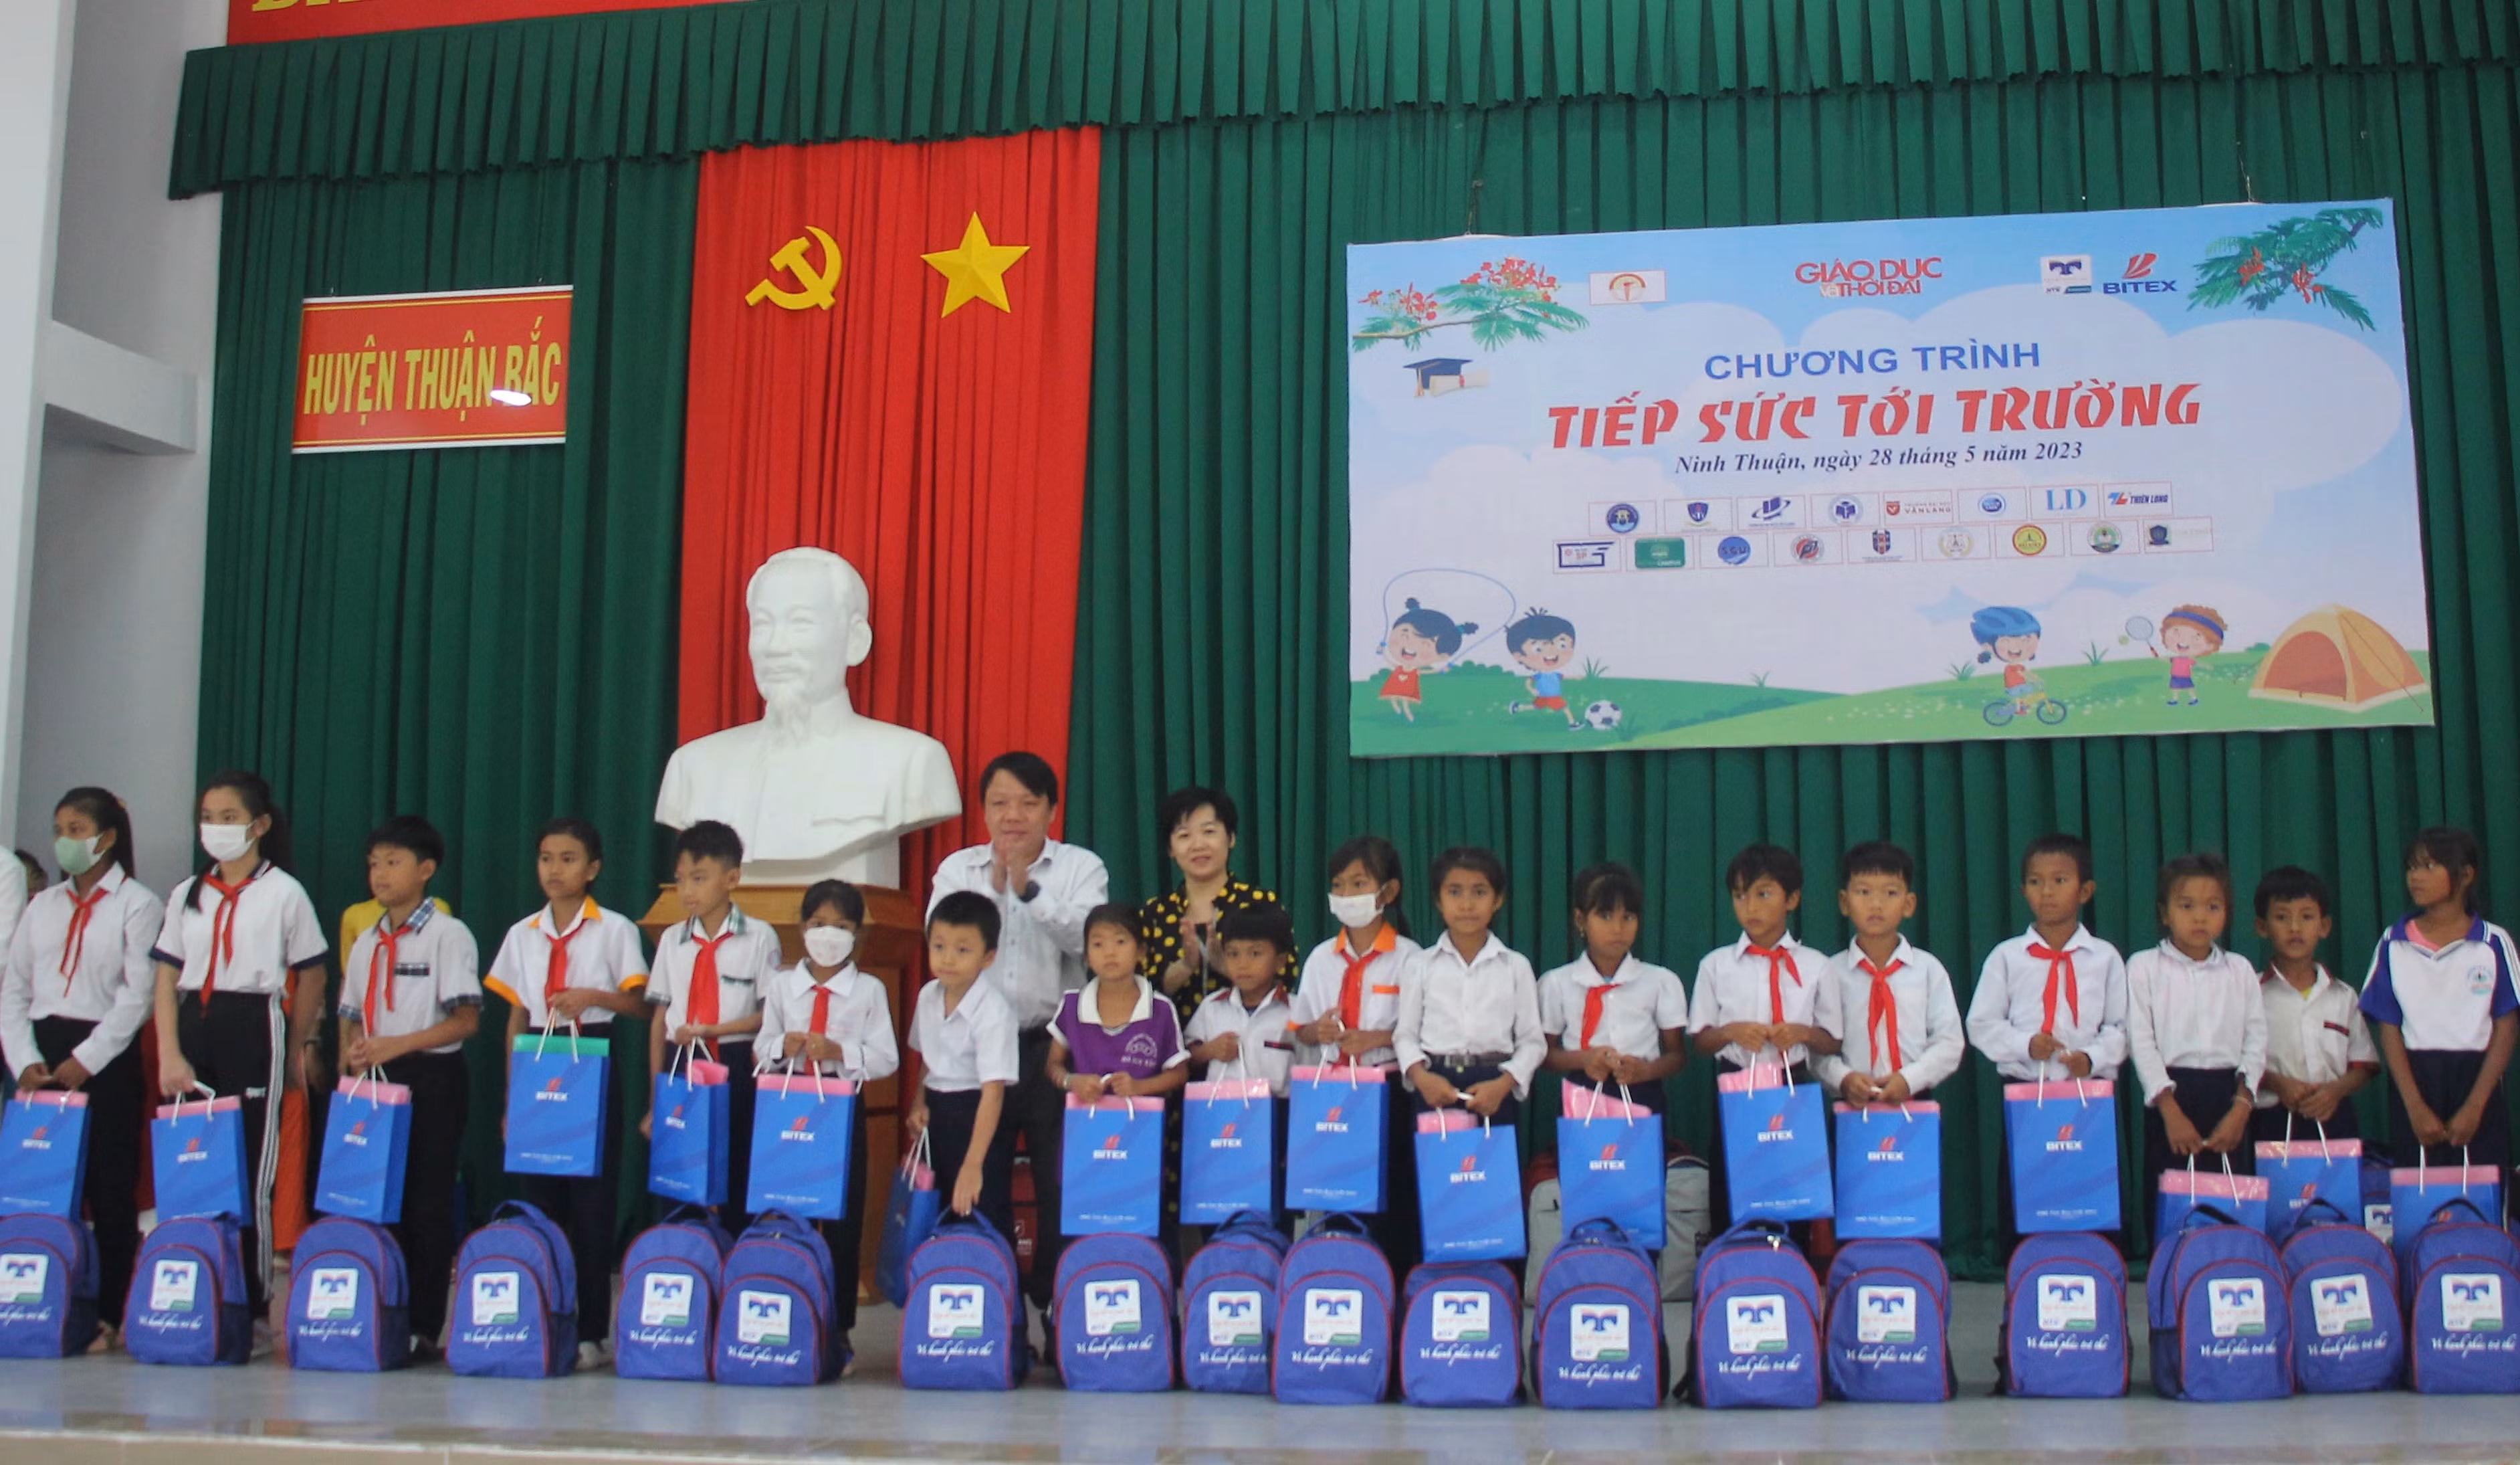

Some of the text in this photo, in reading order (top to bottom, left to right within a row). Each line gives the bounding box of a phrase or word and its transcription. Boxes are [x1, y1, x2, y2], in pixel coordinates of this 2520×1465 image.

[2103, 280, 2177, 294] BITEX
[1705, 338, 2040, 380] CHƯƠNG TRÌNH
[304, 316, 562, 426] HUYỆN THUẬN BẮC
[1548, 378, 2202, 448] TIẾP SỨC TỚI TRƯỜNG
[1675, 442, 2083, 474] Ninh Thuận, ngày 28 tháng 5 năm 2023
[2046, 488, 2087, 510] LD
[1722, 546, 1747, 555] SGU
[1316, 1122, 1349, 1133] BITEX
[780, 1129, 815, 1142] BITEX
[1758, 1130, 1793, 1143] BITEX
[1210, 1138, 1242, 1148] BITEX
[2046, 1140, 2083, 1151] BITEX
[1093, 1149, 1128, 1160] BITEX
[1868, 1151, 1905, 1161] BITEX
[1589, 1159, 1626, 1170] BITEX
[1450, 1171, 1486, 1183] BITEX
